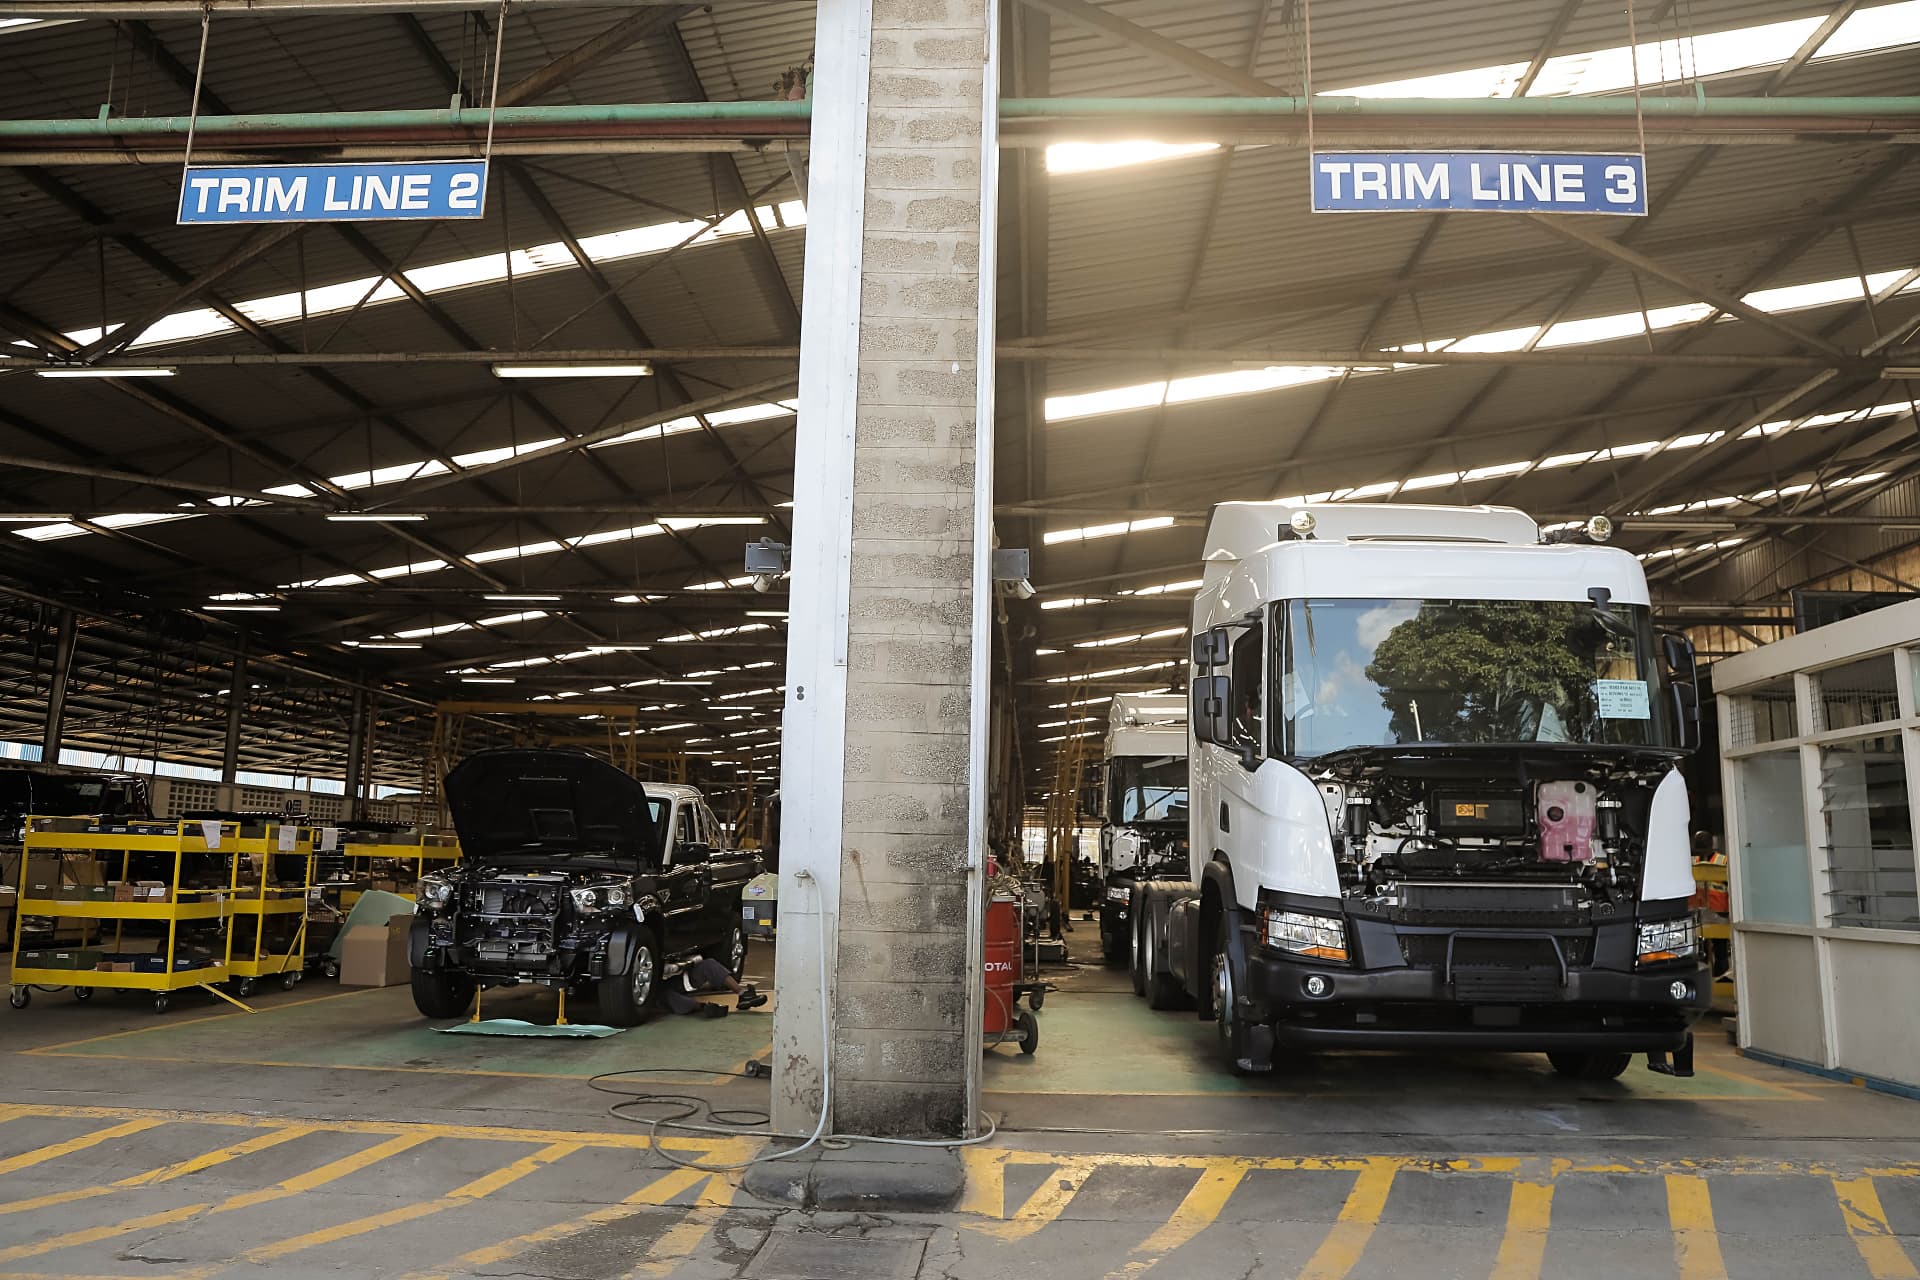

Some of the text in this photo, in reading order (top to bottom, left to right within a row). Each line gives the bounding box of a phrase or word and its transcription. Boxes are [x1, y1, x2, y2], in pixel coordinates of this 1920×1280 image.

[190, 172, 479, 213] TRIM LINE 2
[1319, 162, 1637, 204] TRIM LINE 3
[984, 962, 1012, 971] OTAL
